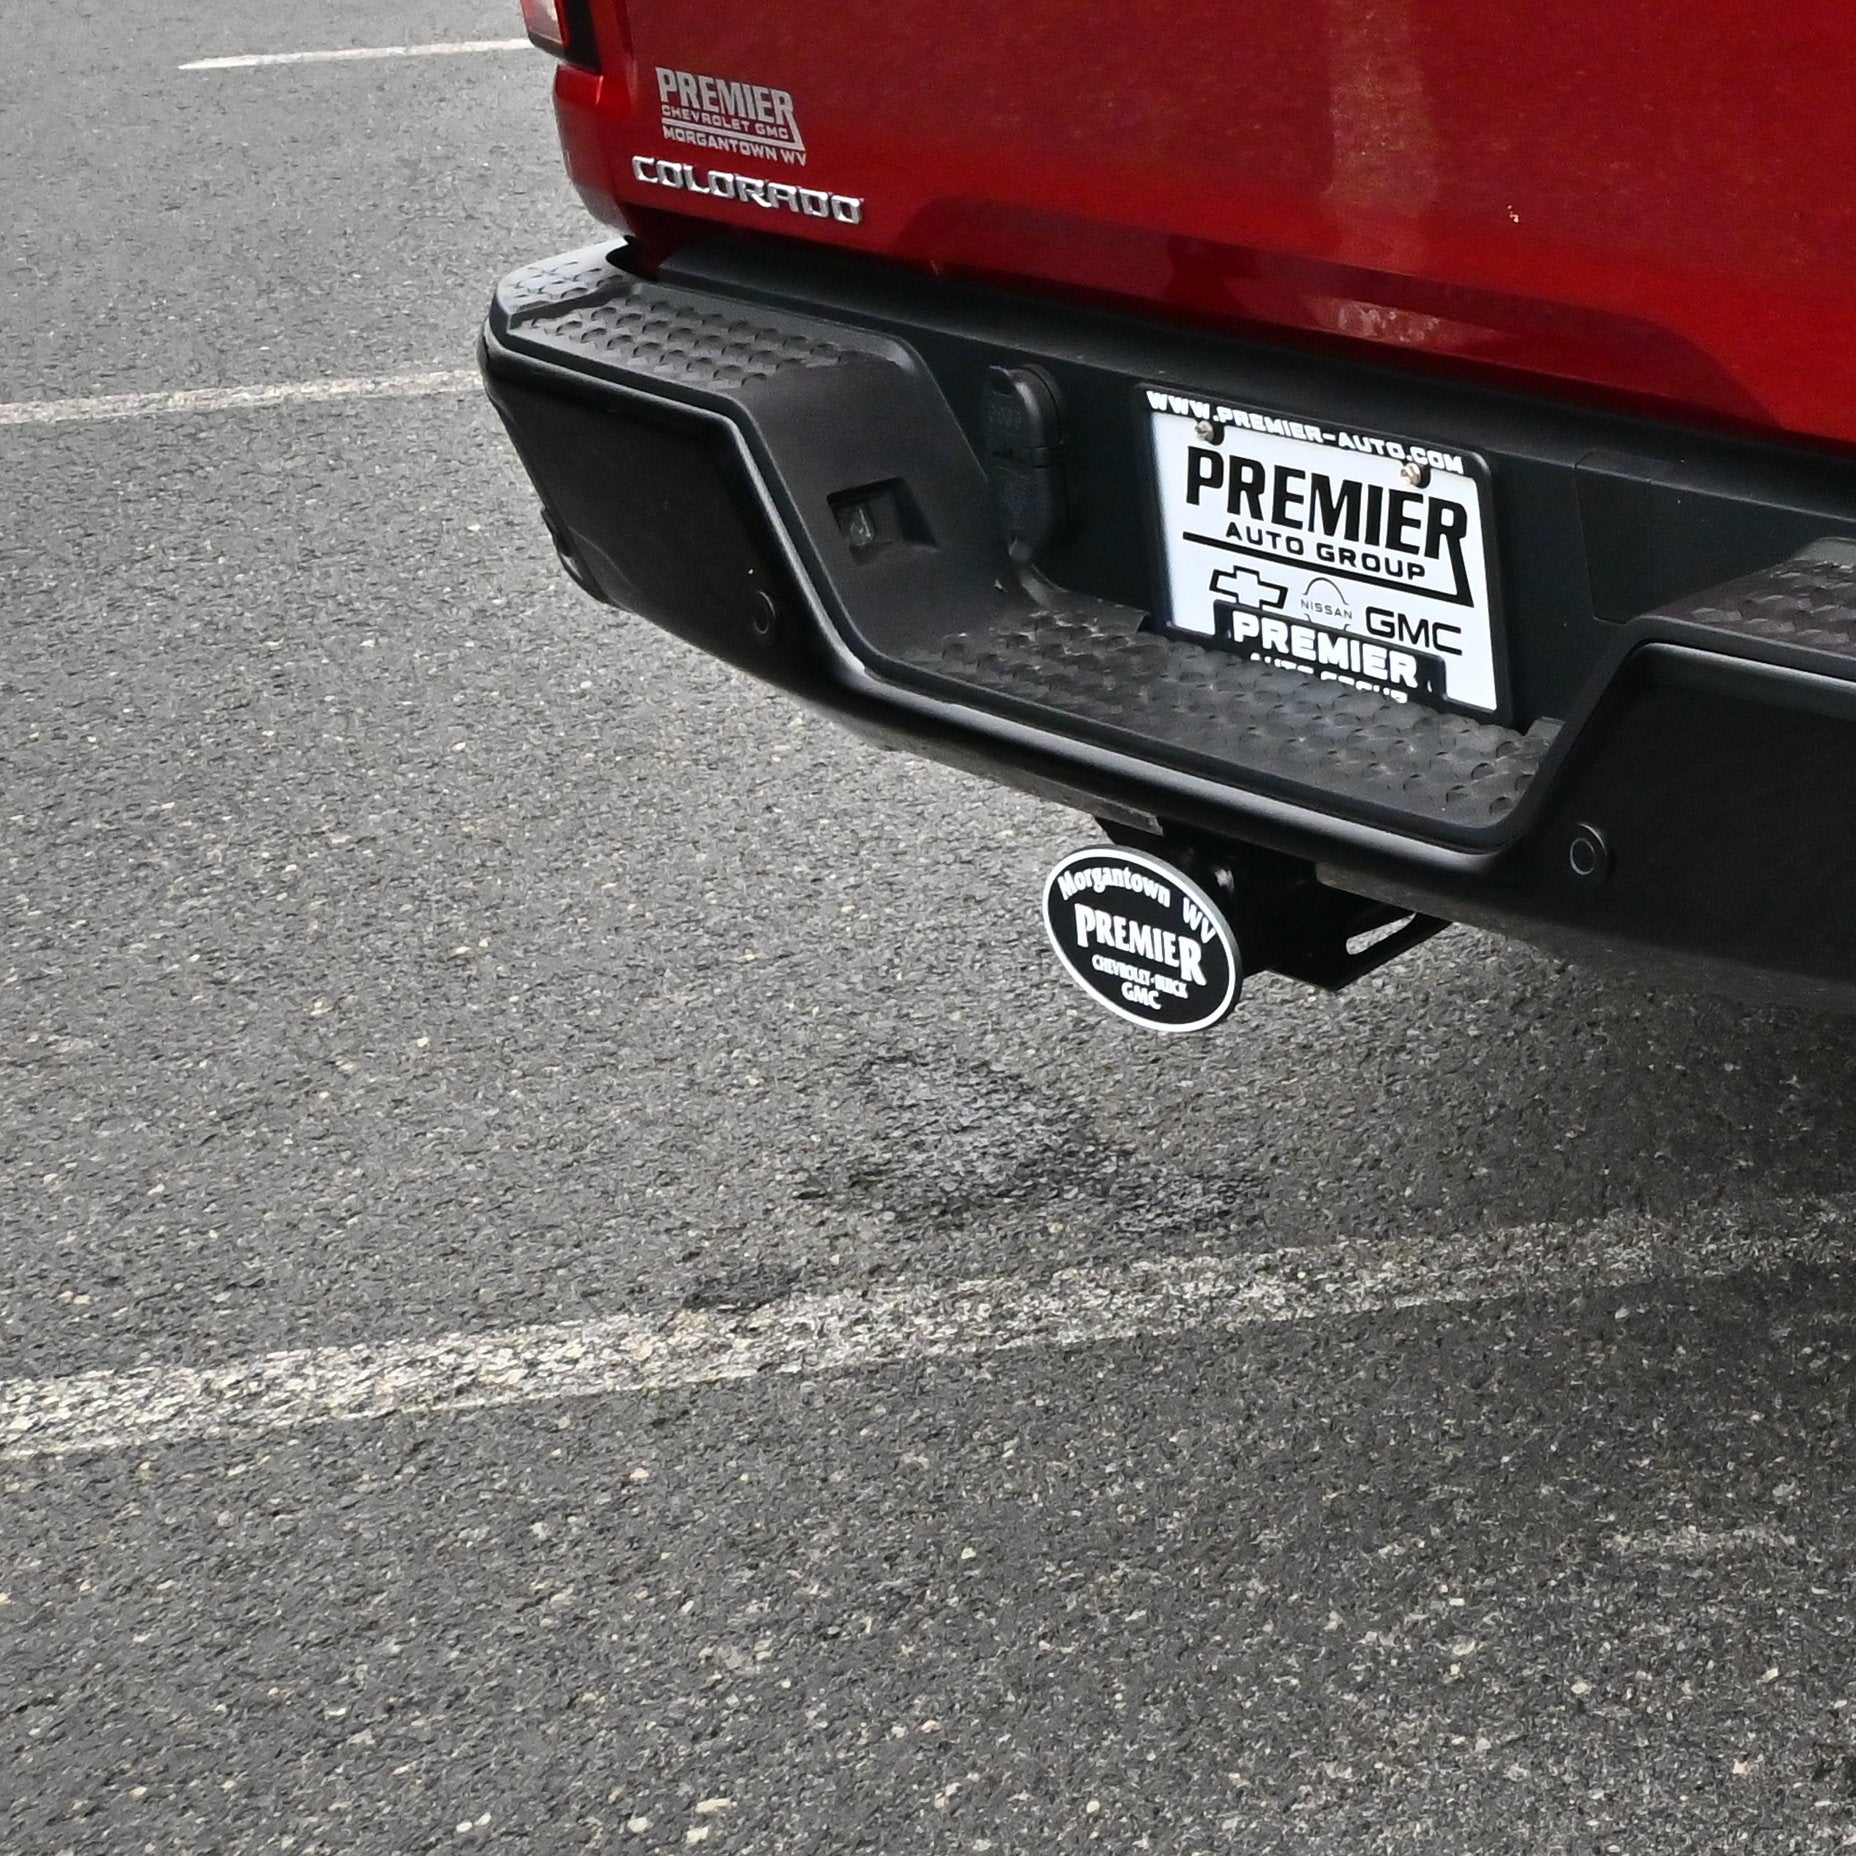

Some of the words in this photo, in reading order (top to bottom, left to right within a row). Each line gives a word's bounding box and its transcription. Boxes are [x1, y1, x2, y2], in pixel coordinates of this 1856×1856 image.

[655, 66, 805, 150] PREMIER
[661, 103, 750, 132] CHEVROLET
[755, 121, 790, 141] GMC
[663, 124, 778, 162] MORGANTOWN
[782, 150, 808, 166] WV
[632, 155, 863, 225] COLORADO
[1146, 390, 1463, 475] WWW.PREMIER-AUTO.COM
[1186, 445, 1474, 607] PREMIER
[1225, 521, 1304, 556] AUTO
[1315, 543, 1426, 581] GROUP
[1300, 598, 1353, 620] NISSAN
[1365, 606, 1463, 657] GMC
[1232, 609, 1418, 689] PREMIER
[1057, 866, 1171, 909] Morgantown
[1182, 897, 1217, 944] WV
[1074, 903, 1207, 986] PREMIER
[1121, 981, 1162, 1010] GMC
